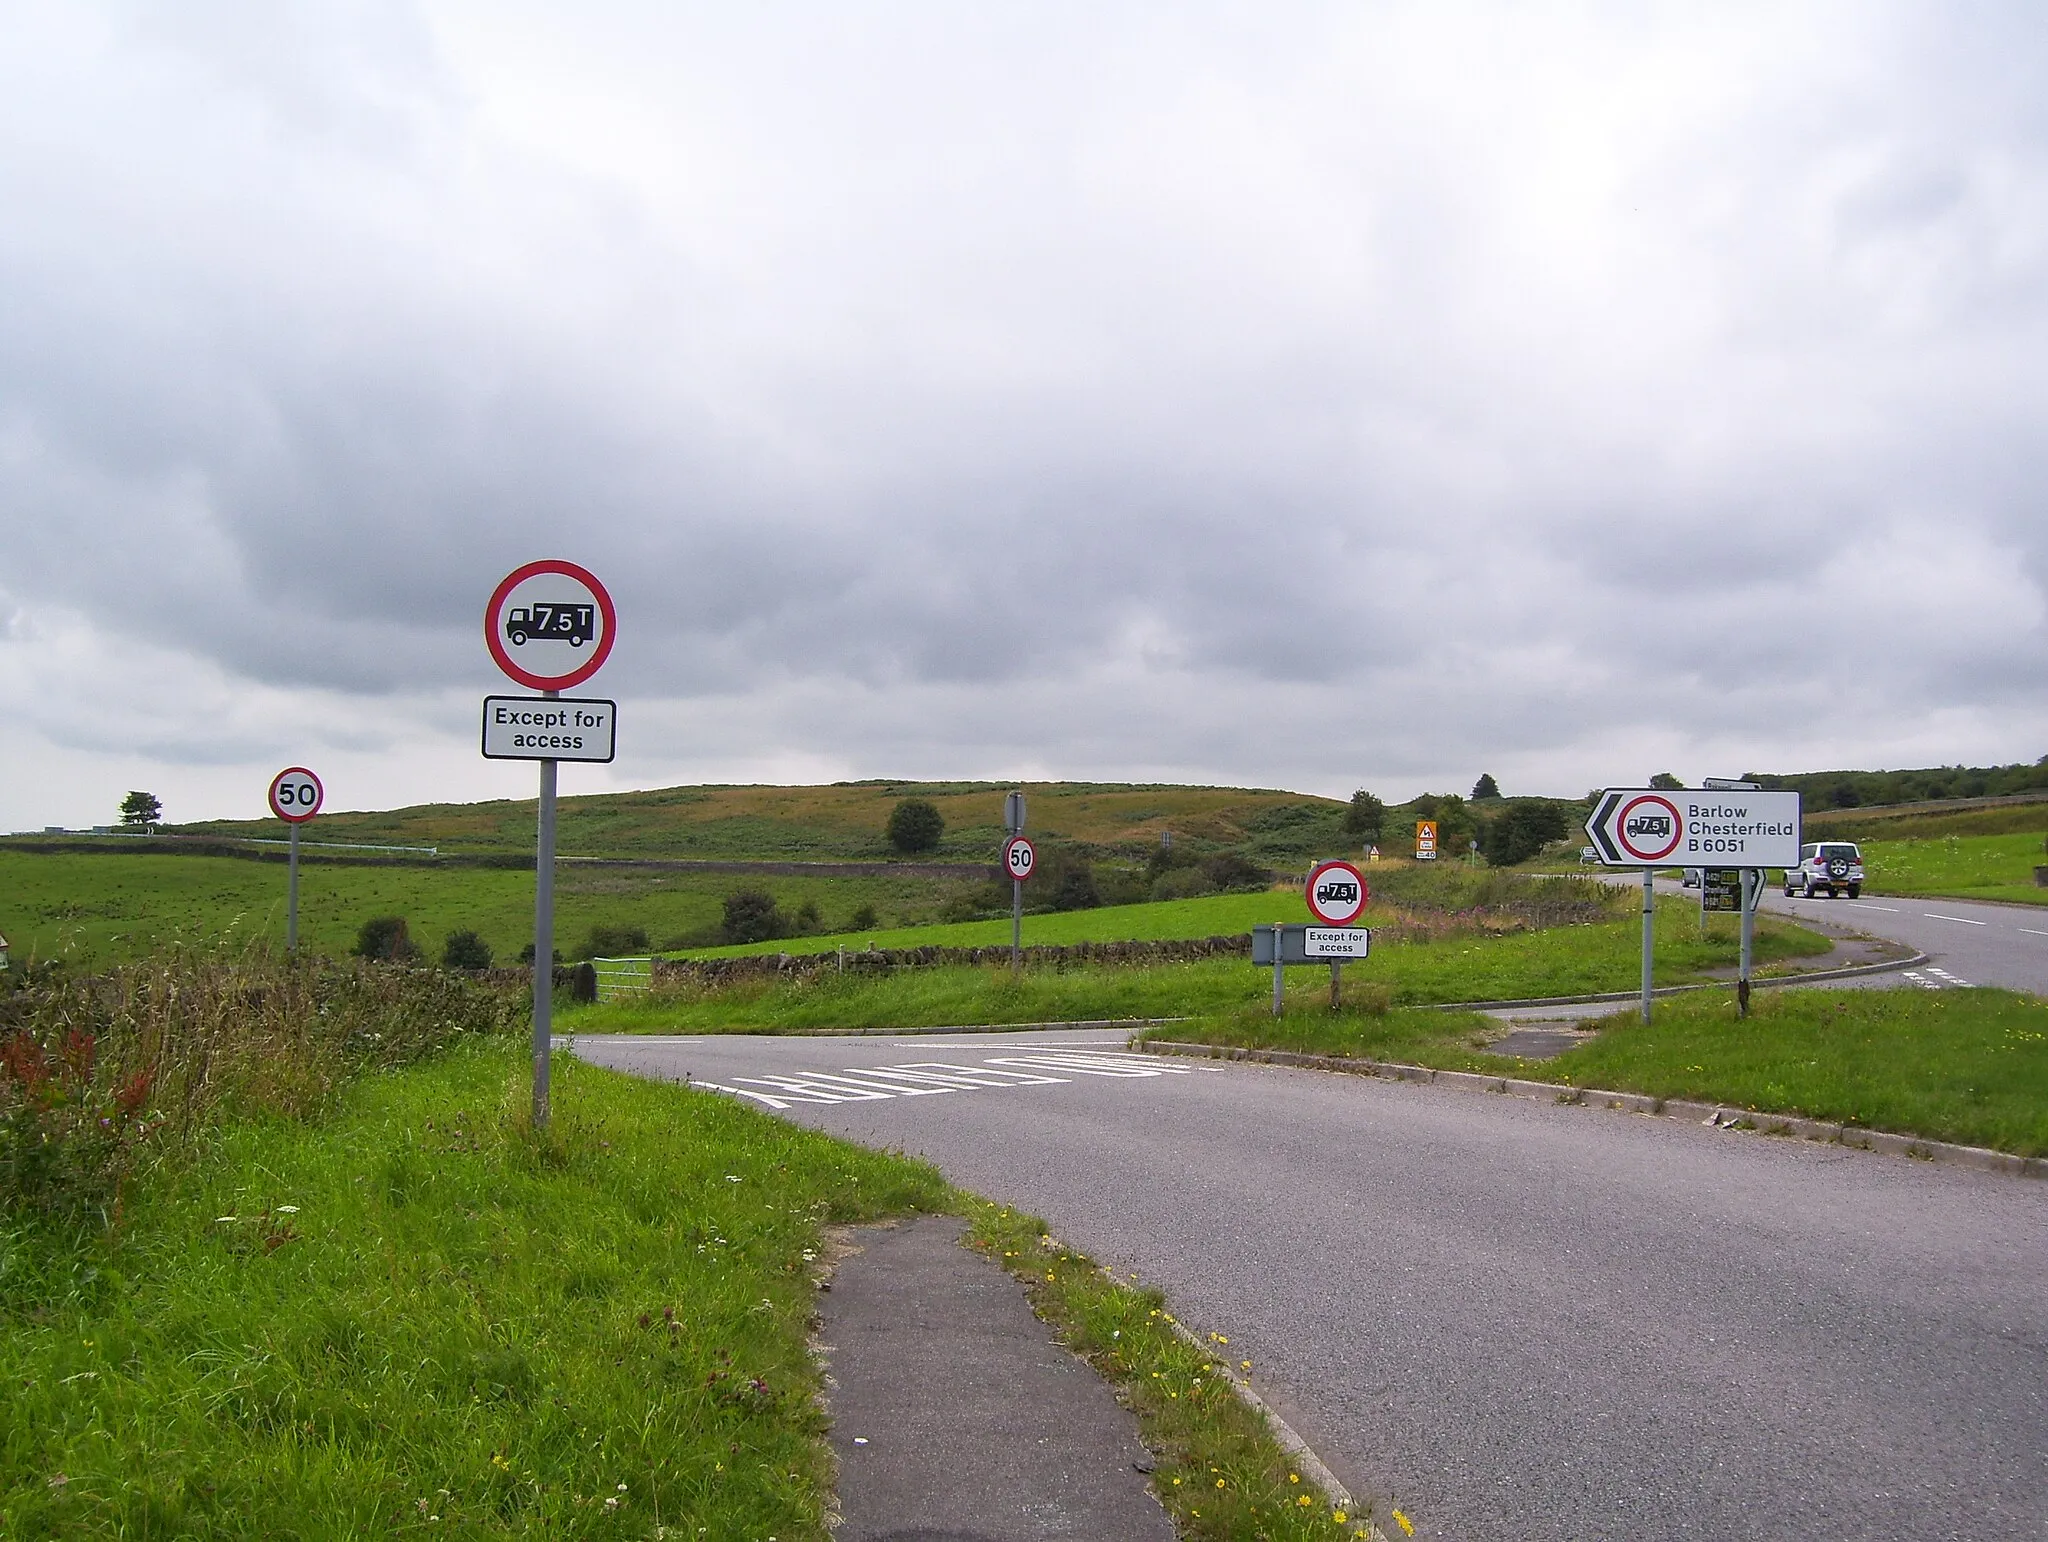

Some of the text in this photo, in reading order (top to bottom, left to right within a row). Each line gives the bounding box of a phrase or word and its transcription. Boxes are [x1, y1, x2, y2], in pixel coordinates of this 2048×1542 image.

[495, 707, 604, 729] Except for
[513, 734, 583, 749] access
[279, 783, 316, 806] 50
[1688, 804, 1747, 818] Barlow
[1688, 821, 1793, 836] Chesterfield
[1010, 849, 1031, 867] 50
[1309, 931, 1364, 943] Except for
[1318, 944, 1353, 952] access
